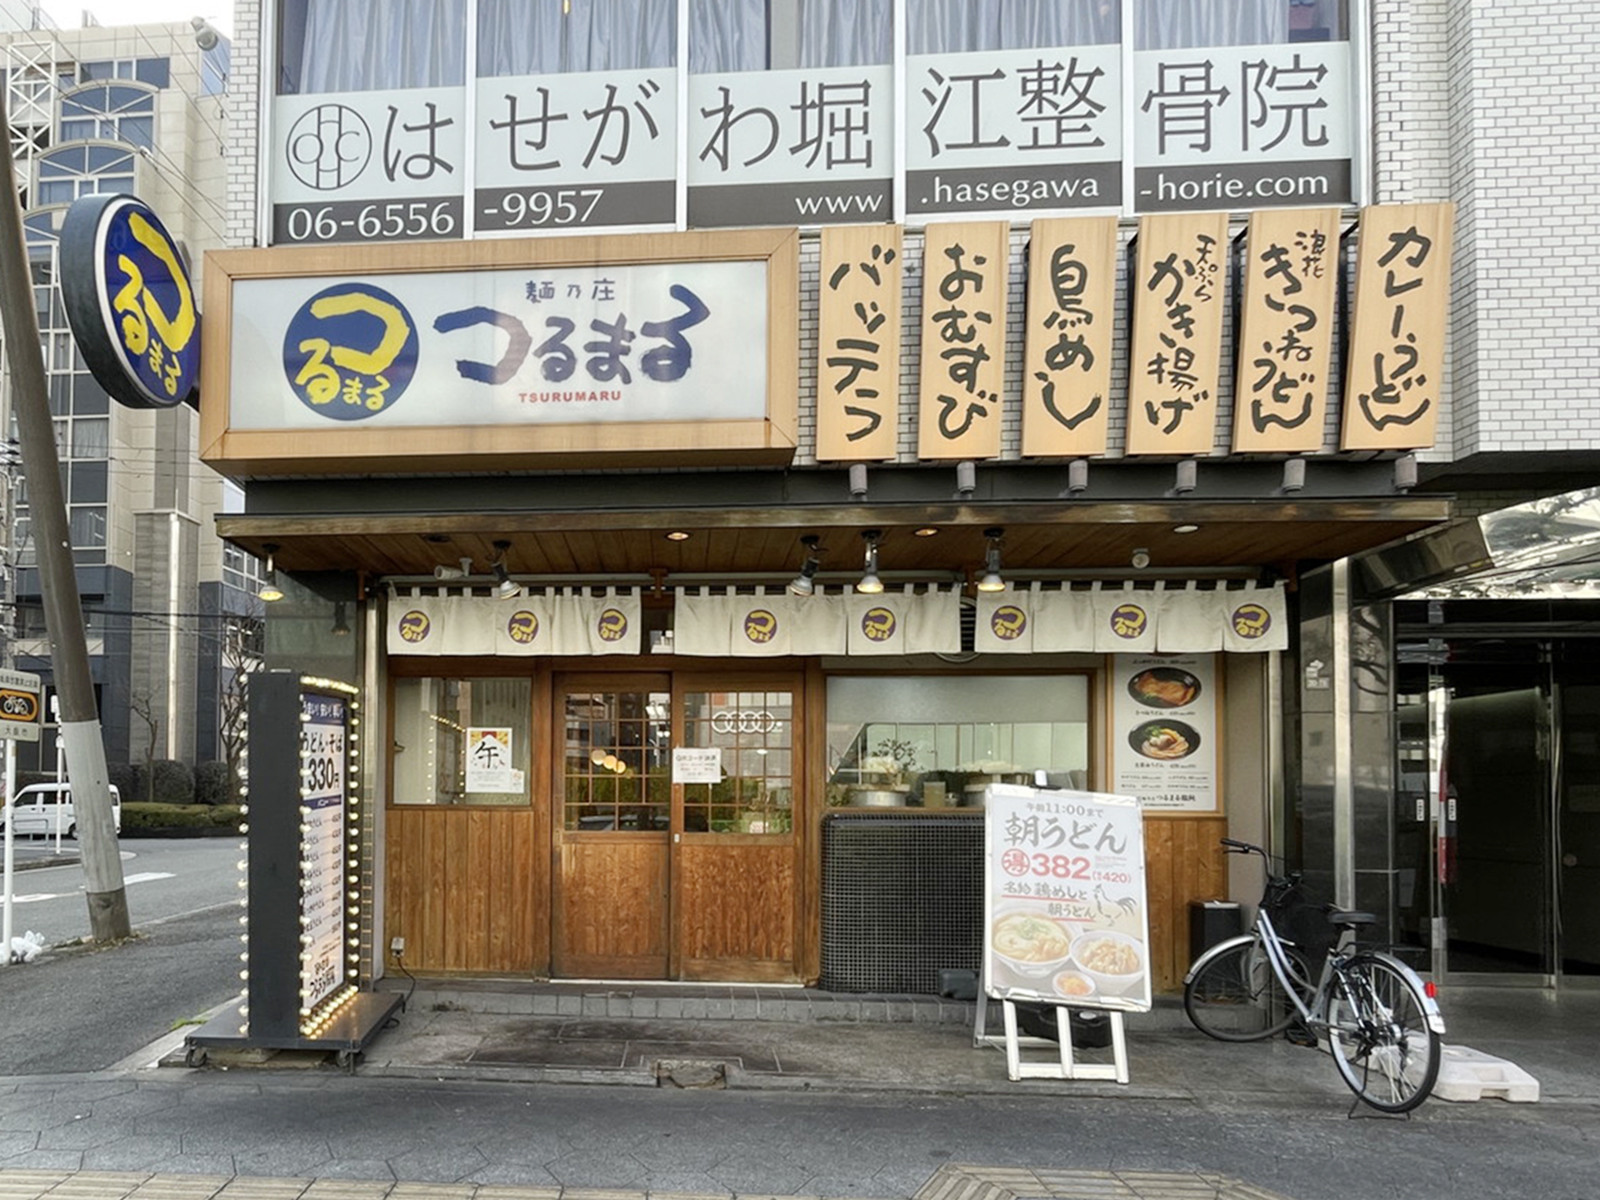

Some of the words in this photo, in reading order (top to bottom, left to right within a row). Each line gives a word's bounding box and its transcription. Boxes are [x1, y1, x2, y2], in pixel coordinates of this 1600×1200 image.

[383, 53, 1328, 182] はせがわ堀江整骨院
[113, 211, 197, 397] つるまる
[1194, 233, 1218, 302] 天ぷら
[1294, 229, 1326, 278] 浪花
[295, 292, 411, 411] つるまる
[433, 284, 711, 385] つるまる
[932, 243, 998, 440] おむすび
[1034, 244, 1102, 430] 鳥めし
[1145, 253, 1209, 434] かき揚げ
[1251, 244, 1317, 433] きつねうどん
[1358, 226, 1432, 431] カレーうどん
[518, 390, 622, 404] TSURUMARU
[475, 741, 499, 769] 午
[1004, 812, 1127, 854] 朝うどん
[1031, 852, 1091, 880] 382
[1048, 903, 1096, 919] 朝うどん
